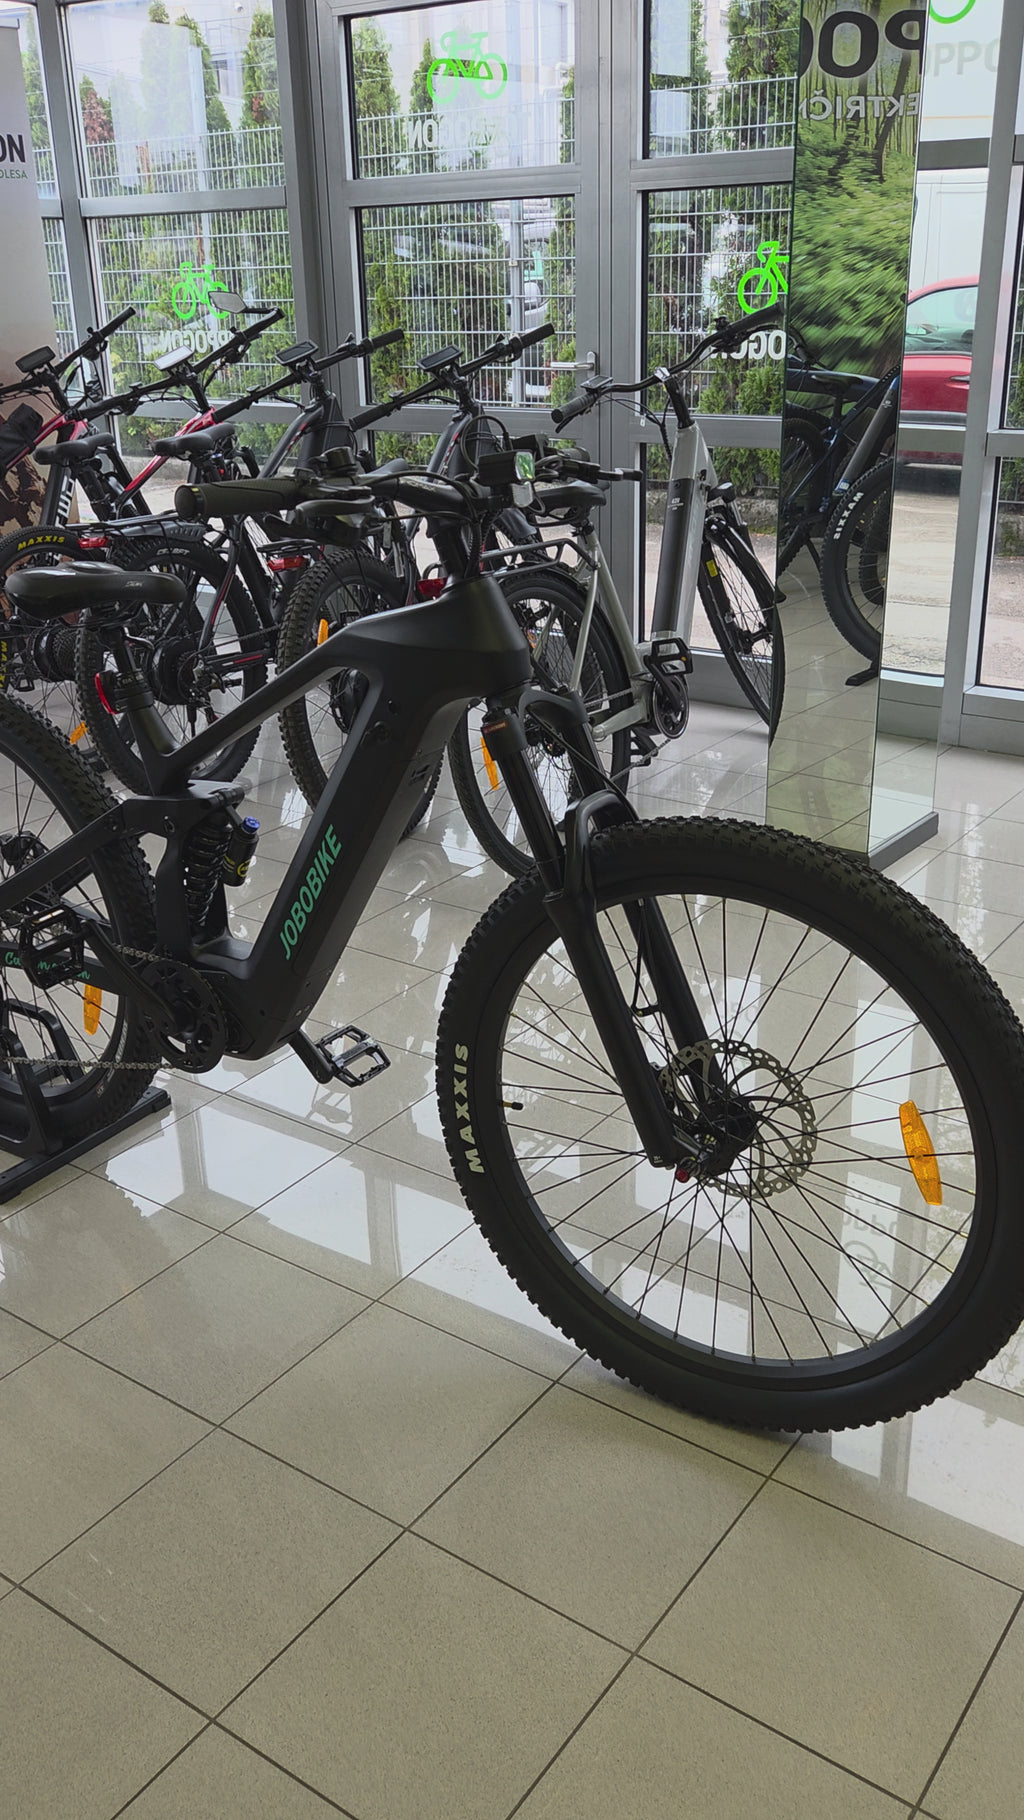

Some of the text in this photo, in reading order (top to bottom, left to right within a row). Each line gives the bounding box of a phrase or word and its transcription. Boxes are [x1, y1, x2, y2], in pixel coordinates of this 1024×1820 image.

[17, 535, 65, 551] MAXXIS
[280, 823, 343, 961] JOBOBIKE
[453, 1043, 486, 1174] MAXXIS
